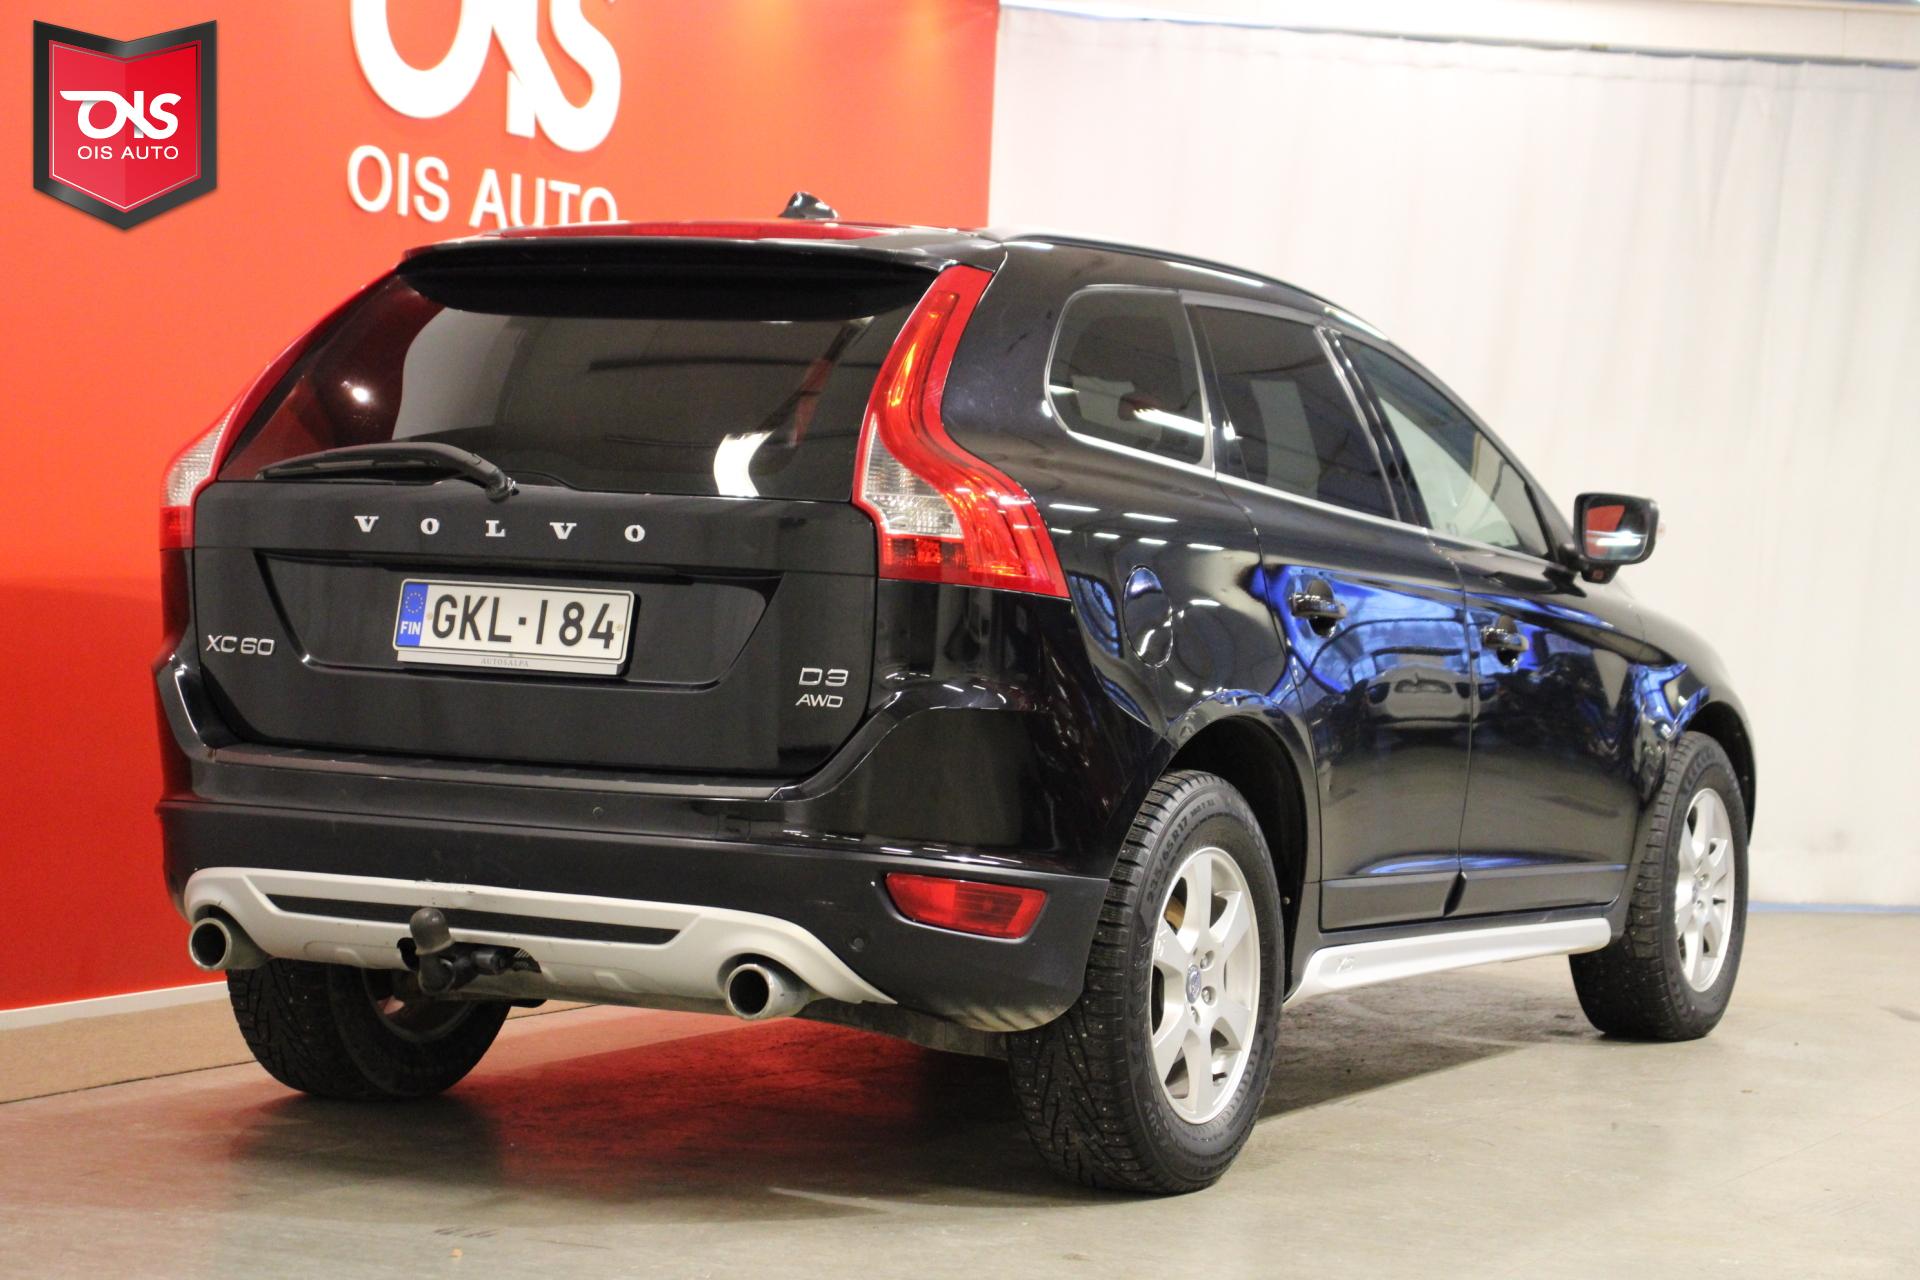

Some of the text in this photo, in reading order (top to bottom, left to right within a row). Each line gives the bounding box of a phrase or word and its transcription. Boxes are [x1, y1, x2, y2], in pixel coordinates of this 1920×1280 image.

[347, 145, 619, 229] OIS AUTO
[354, 515, 646, 543] VOLVO
[399, 620, 422, 636] FIN
[799, 667, 849, 687] D3
[795, 693, 844, 708] AWD
